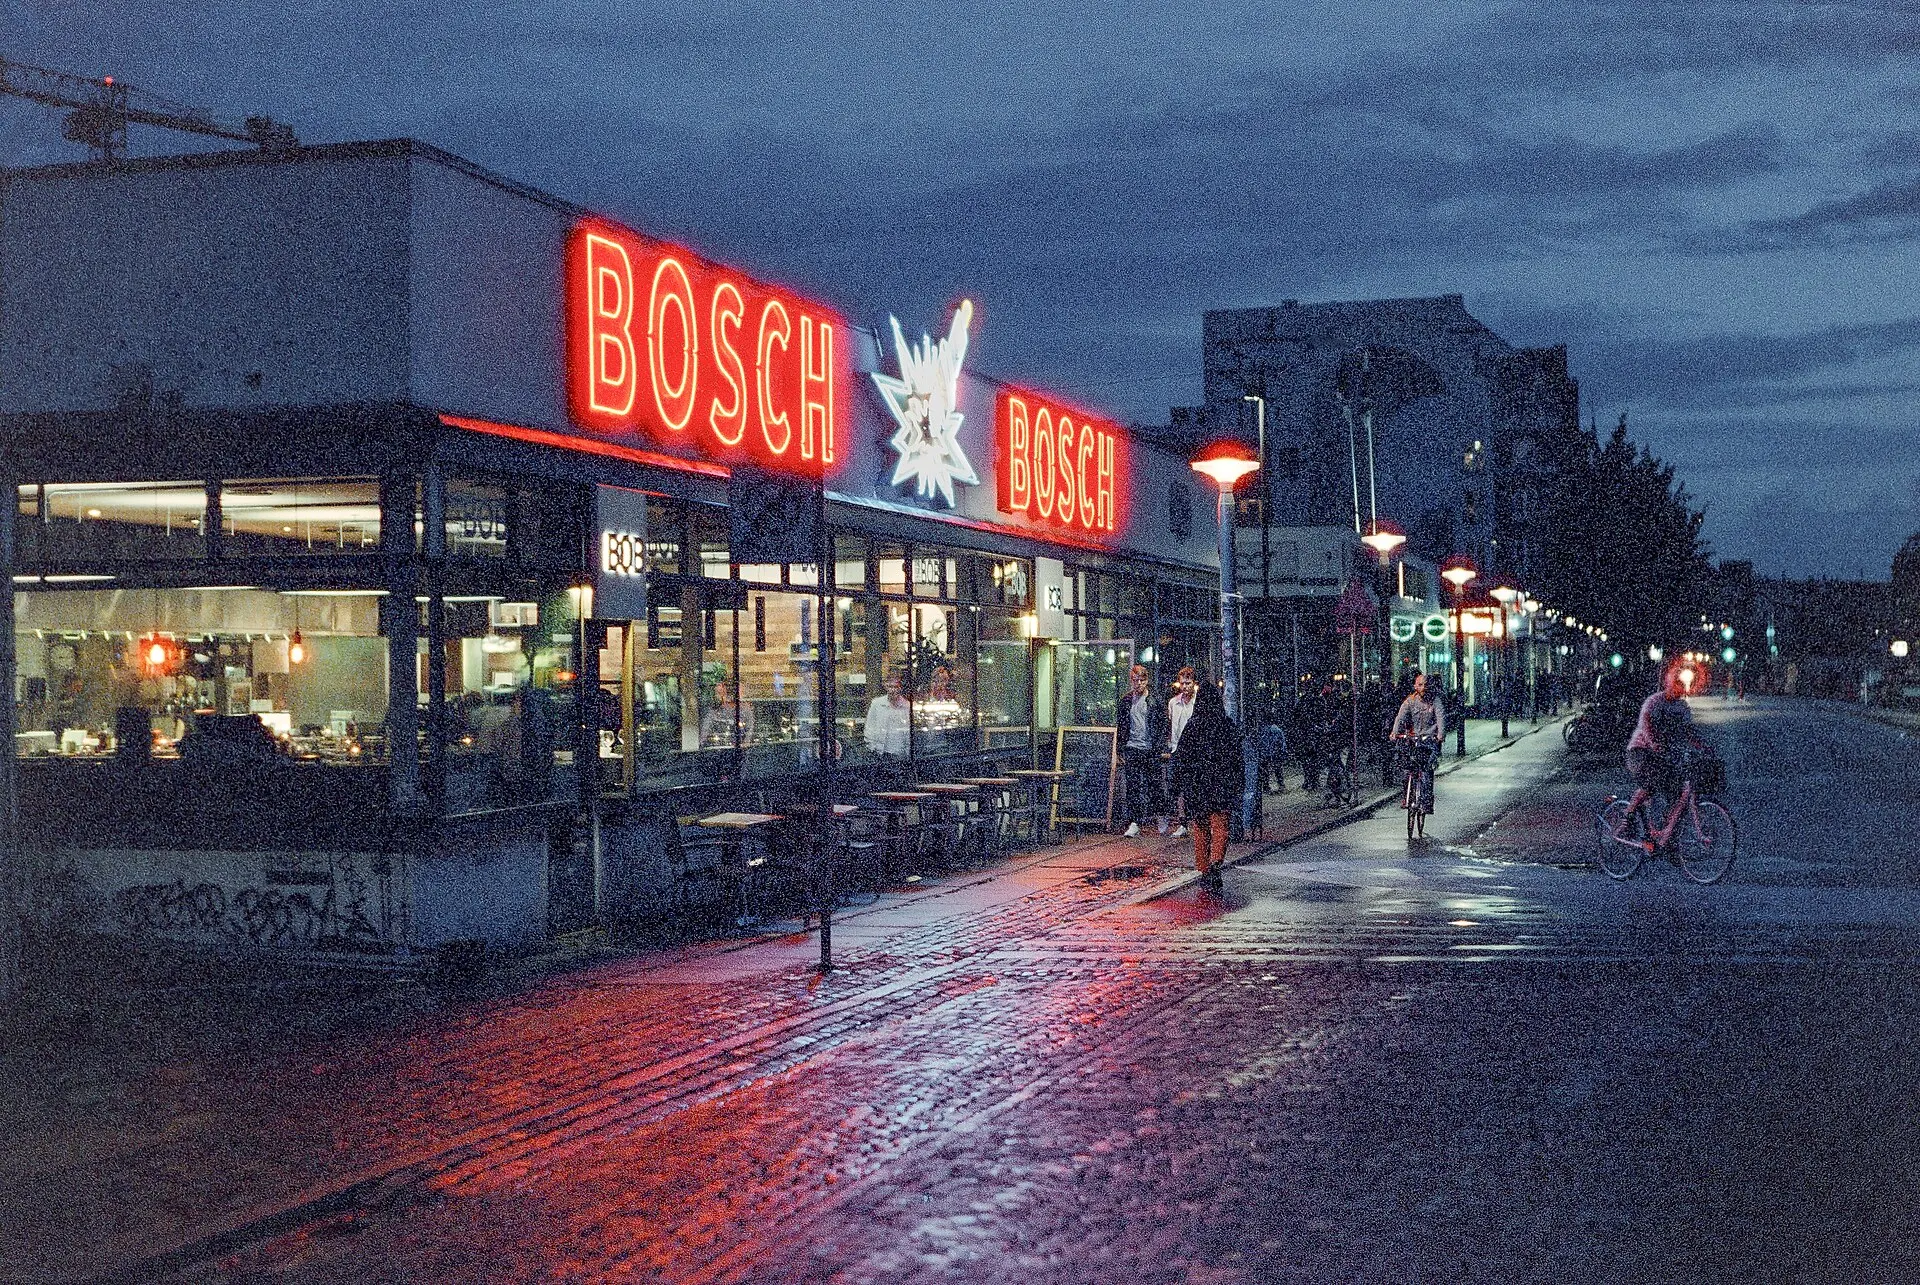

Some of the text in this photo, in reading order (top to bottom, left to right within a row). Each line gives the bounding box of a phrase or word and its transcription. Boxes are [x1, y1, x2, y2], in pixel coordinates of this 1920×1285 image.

[586, 232, 834, 464] BOSCH
[1009, 397, 1114, 531] BOSCH
[608, 532, 644, 574] BOB
